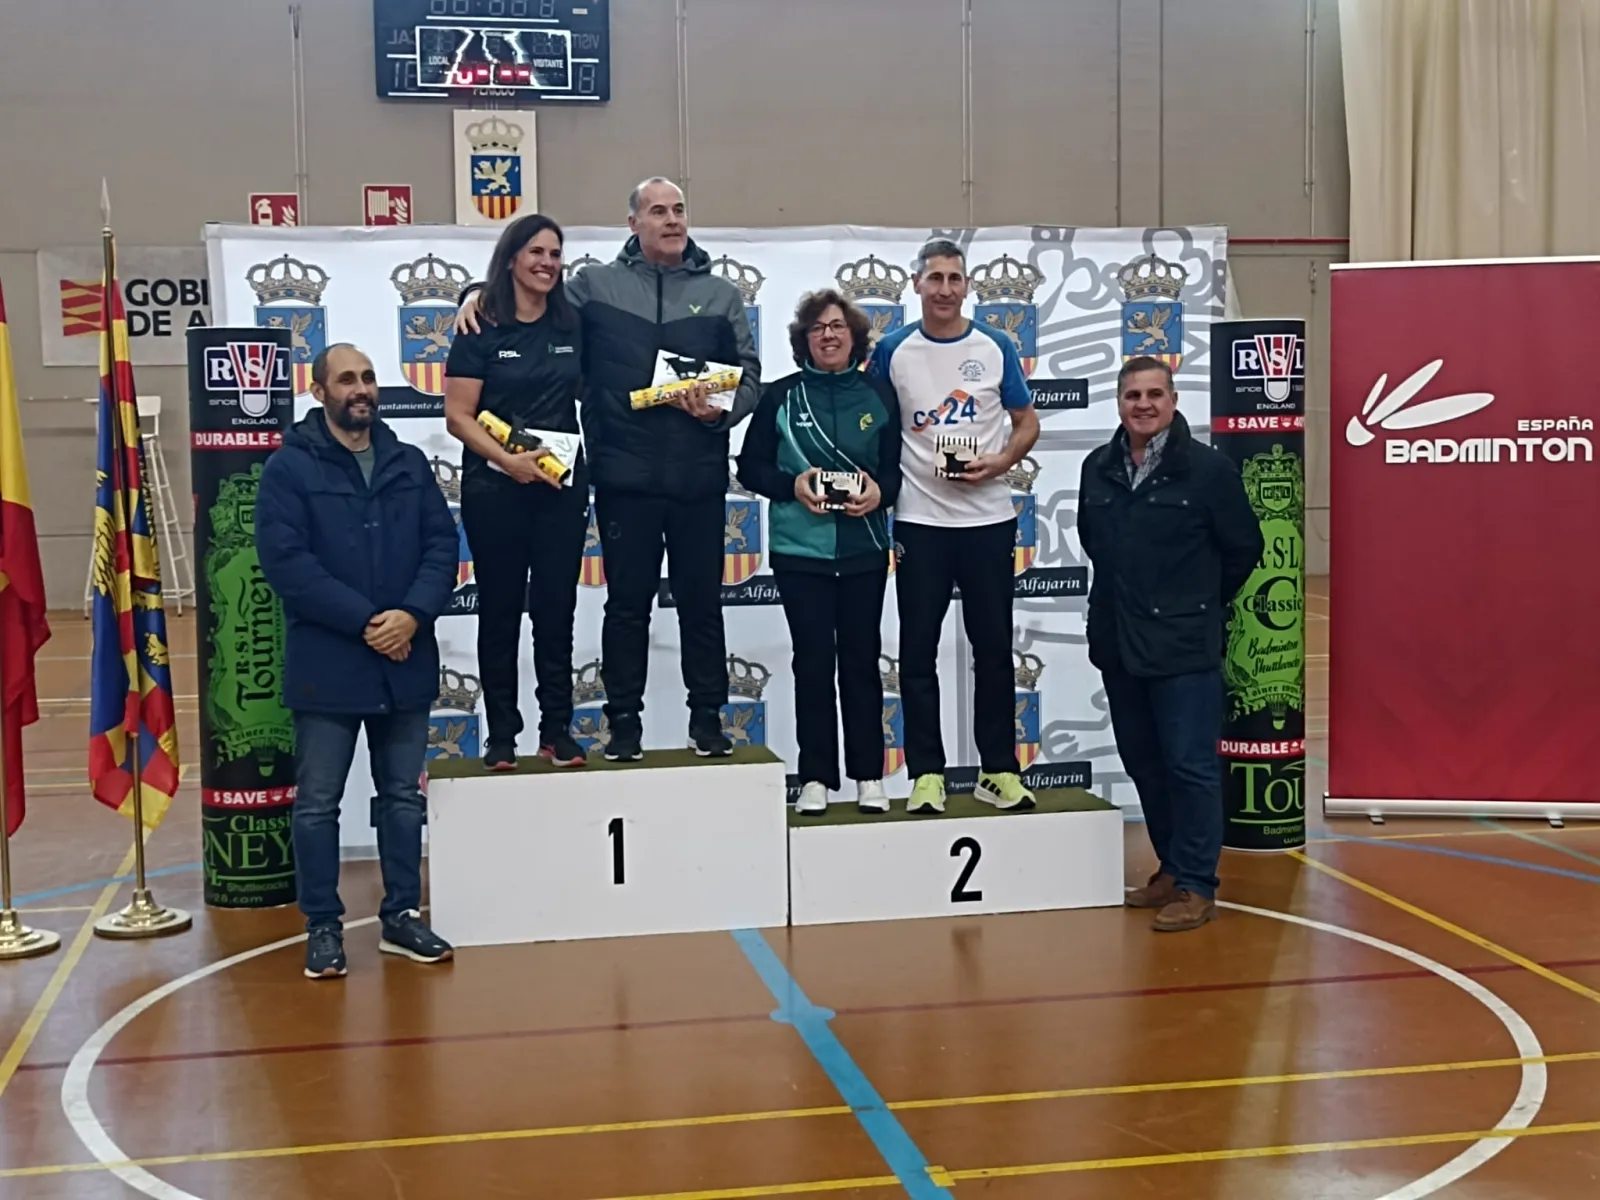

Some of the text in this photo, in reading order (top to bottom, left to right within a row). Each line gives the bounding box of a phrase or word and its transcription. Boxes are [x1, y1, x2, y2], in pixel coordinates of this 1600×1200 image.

[429, 56, 450, 65] LOCAL
[533, 58, 564, 69] VISITANTE
[127, 310, 171, 336] DE
[498, 350, 521, 359] RSL
[1237, 347, 1305, 371] RSL
[209, 356, 289, 381] RSL
[1237, 416, 1279, 429] SAVE
[1517, 415, 1594, 431] ESPAÑA
[195, 433, 269, 446] DURABLE
[1385, 436, 1593, 463] BADMINTON
[1243, 594, 1303, 613] Classic
[1247, 637, 1299, 659] Badminton
[1221, 740, 1289, 754] DURABLE
[223, 791, 268, 804] SAVE
[608, 818, 625, 885] 1
[950, 837, 983, 903] 2
